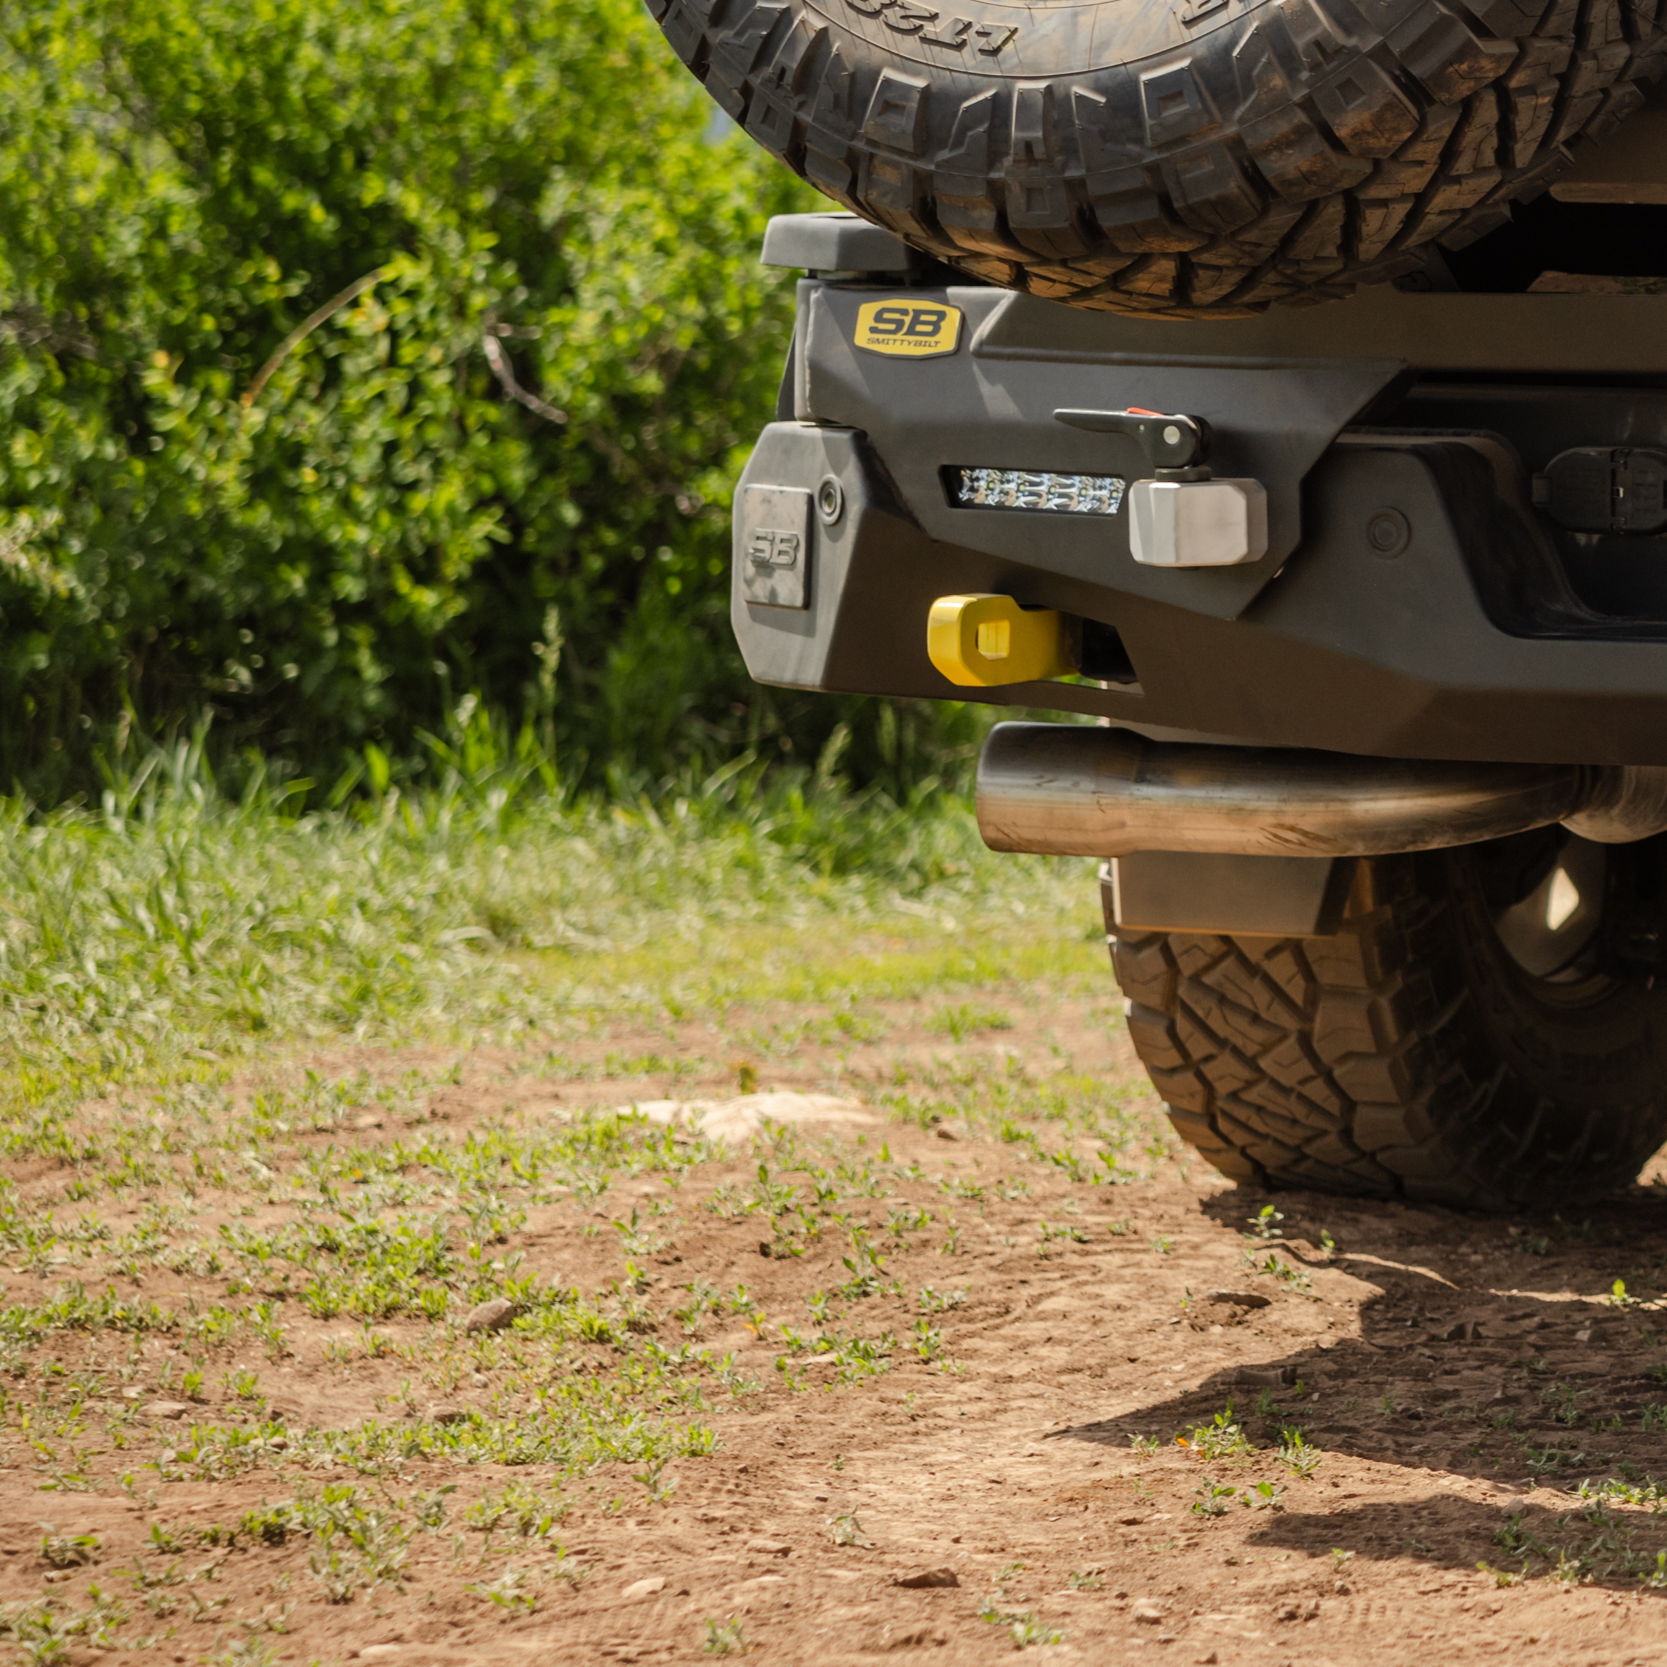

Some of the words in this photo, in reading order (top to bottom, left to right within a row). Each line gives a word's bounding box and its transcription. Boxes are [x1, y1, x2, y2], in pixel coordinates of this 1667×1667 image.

[867, 307, 947, 337] SB
[866, 337, 942, 349] SMITTYBILT
[745, 527, 800, 570] SB
